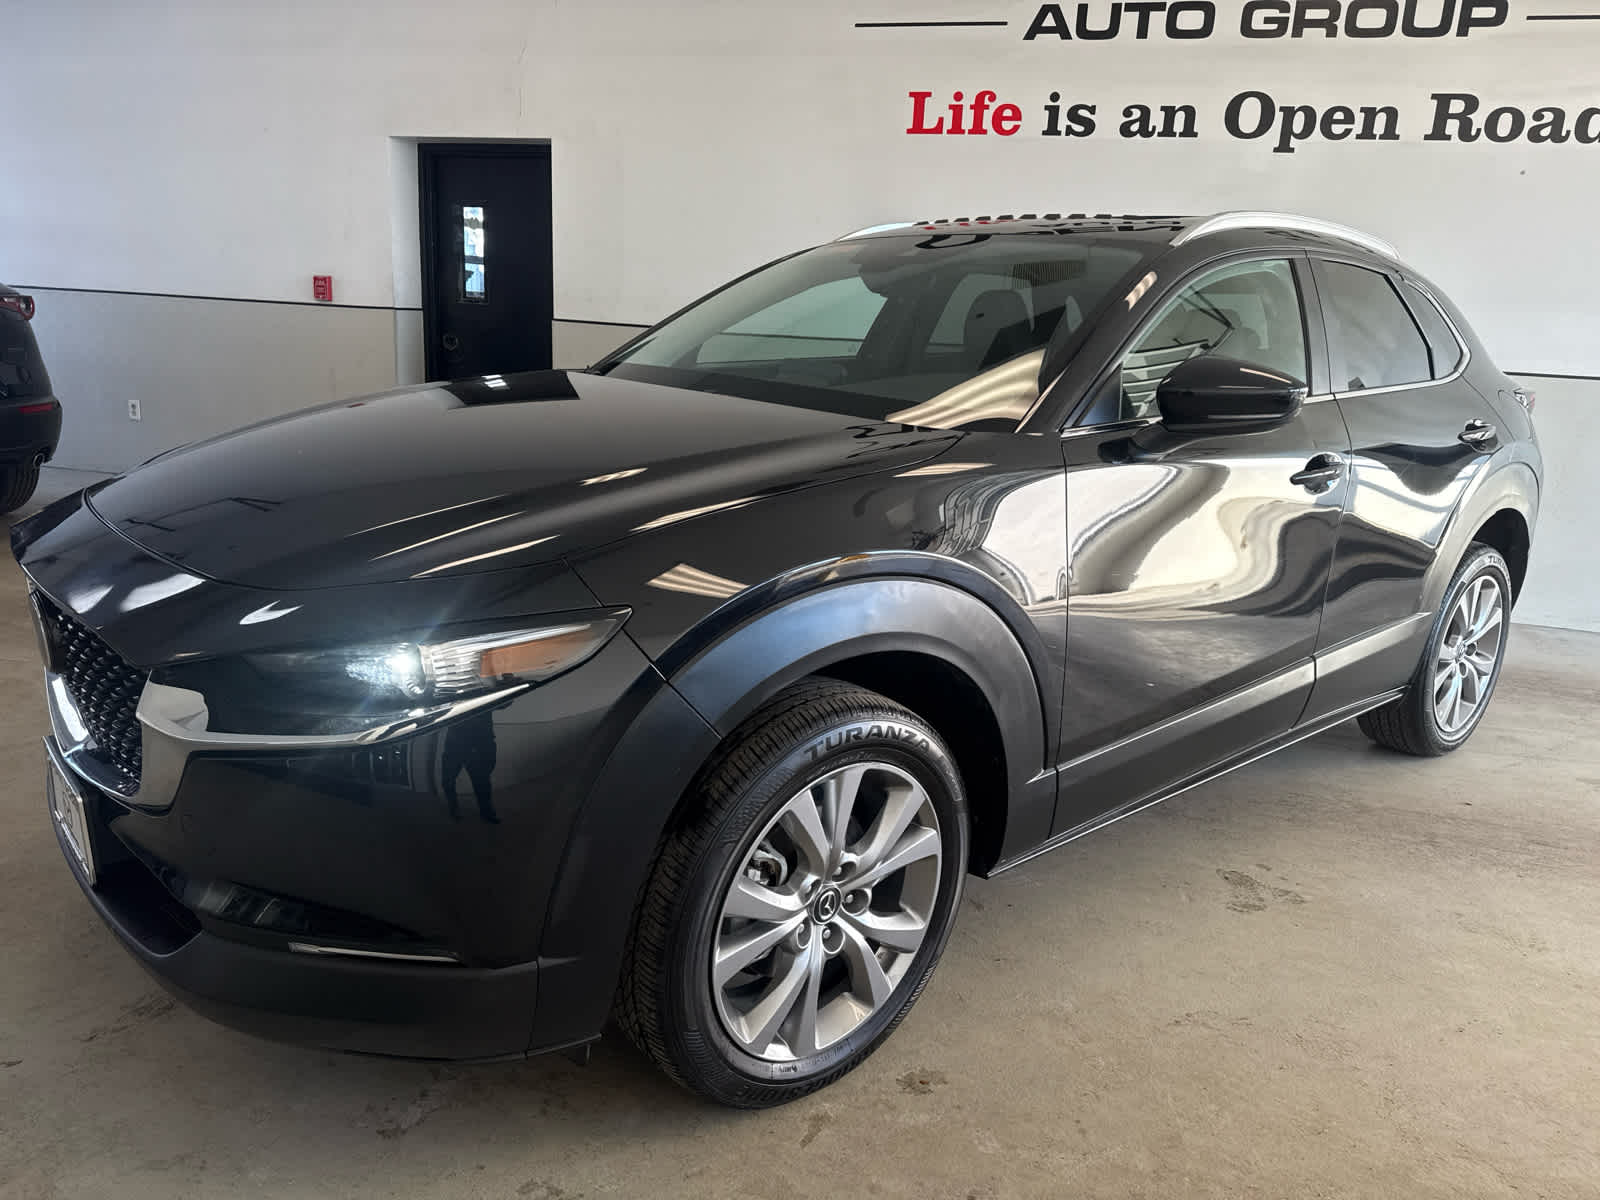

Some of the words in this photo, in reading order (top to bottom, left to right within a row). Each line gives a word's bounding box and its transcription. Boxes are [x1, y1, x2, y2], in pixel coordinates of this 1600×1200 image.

[1022, 1, 1216, 41] AUTO
[1239, 0, 1509, 39] GROUP
[906, 90, 1023, 137] Life
[1041, 91, 1097, 138] is
[1119, 104, 1199, 139] an
[1224, 90, 1401, 154] Open
[803, 724, 931, 761] TURANZA
